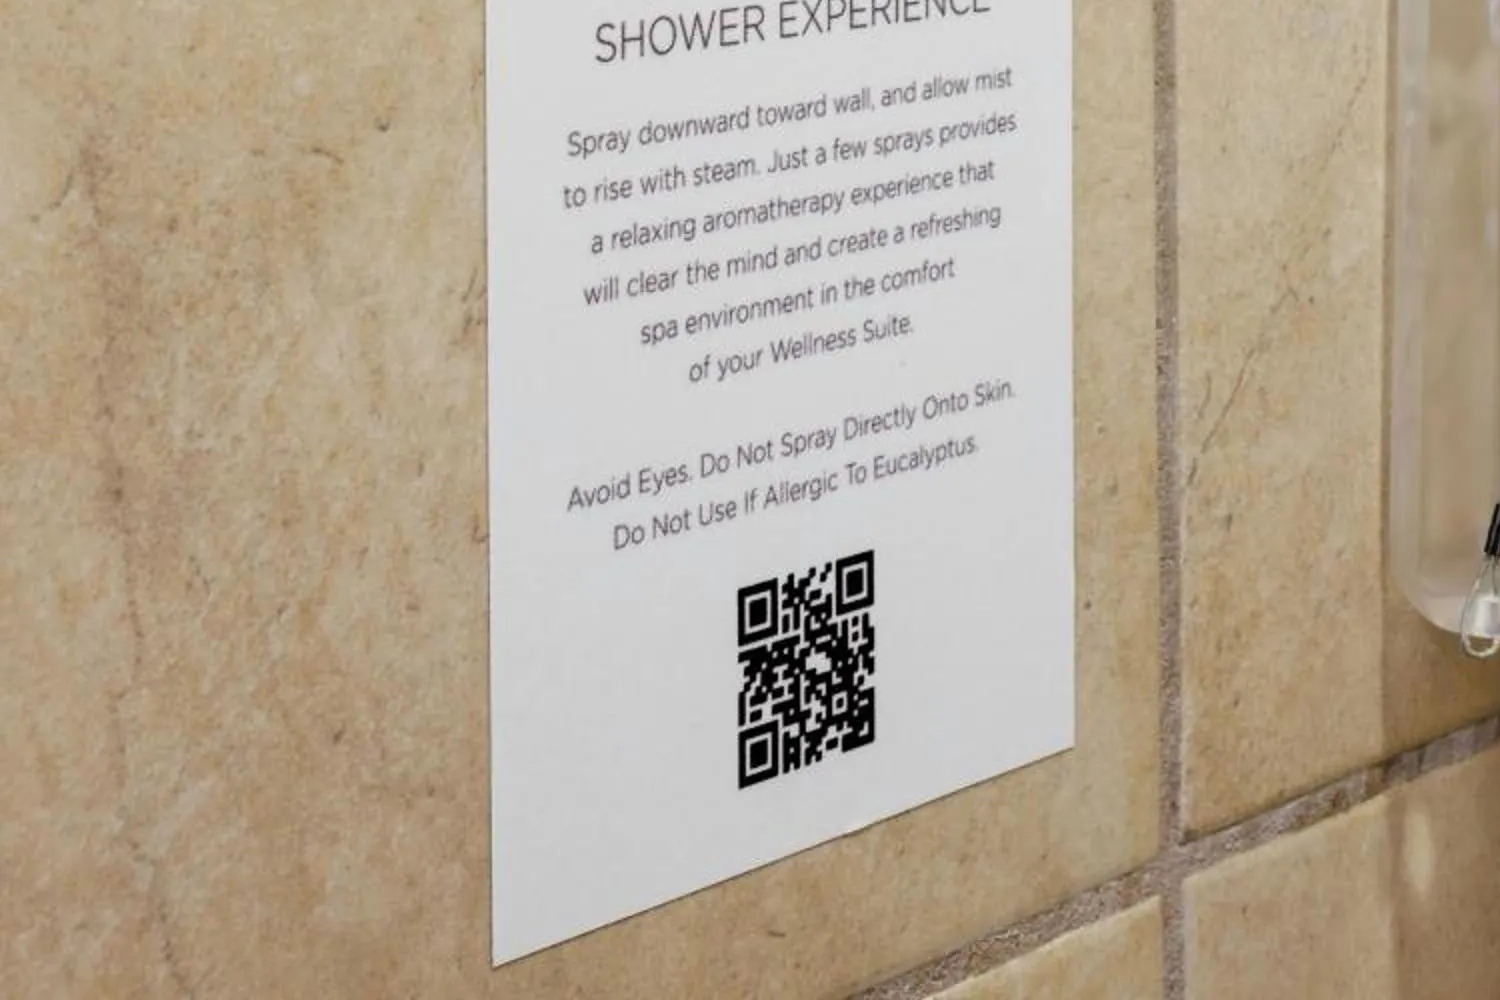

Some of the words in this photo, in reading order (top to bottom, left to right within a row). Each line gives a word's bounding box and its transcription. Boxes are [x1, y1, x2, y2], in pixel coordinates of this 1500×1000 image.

[594, 3, 766, 65] SHOWER
[562, 185, 588, 210] to
[593, 176, 634, 204] rise
[639, 164, 688, 196] with
[691, 157, 761, 188] steam.
[767, 145, 809, 174] Just
[814, 145, 828, 167] a
[831, 137, 869, 162] few
[872, 127, 935, 158] sprays
[938, 112, 1018, 149] provides
[566, 129, 632, 161] Spray
[637, 104, 751, 147] downward
[755, 93, 828, 128] toward
[832, 87, 876, 115] wall,
[879, 80, 917, 108] and
[920, 74, 970, 102] allow
[974, 66, 1013, 91] mist
[590, 234, 605, 256] a
[610, 217, 697, 251] relaxing
[702, 190, 846, 234] aromatherapy
[849, 169, 955, 207] experience
[957, 160, 996, 186] that
[582, 275, 620, 307] will
[625, 268, 680, 298] clear
[685, 258, 721, 287] the
[725, 244, 779, 279] mind
[783, 235, 823, 268] and
[826, 227, 889, 258] create
[892, 224, 906, 245] a
[909, 206, 1002, 241] refreshing
[639, 318, 680, 347] spa
[684, 286, 815, 336] environment
[820, 282, 839, 306] in
[842, 276, 877, 301] the
[878, 257, 956, 294] comfort
[688, 353, 712, 384] of
[716, 347, 765, 383] your
[769, 327, 858, 364] Wellness
[862, 314, 914, 344] Suite.
[566, 471, 632, 513] Avoid
[637, 463, 694, 496] Eyes.
[699, 451, 731, 479] Do
[736, 439, 775, 470] Not
[779, 426, 838, 459] Spray
[843, 402, 918, 442] Directly
[921, 391, 970, 421] Onto
[973, 378, 1016, 408] Skin.
[612, 523, 646, 552] Do
[651, 507, 693, 541] Not
[697, 499, 738, 528] Use
[743, 487, 759, 516] If
[762, 471, 839, 510] Allergic
[843, 461, 869, 486] To
[872, 435, 979, 481] Eucalyptus.
